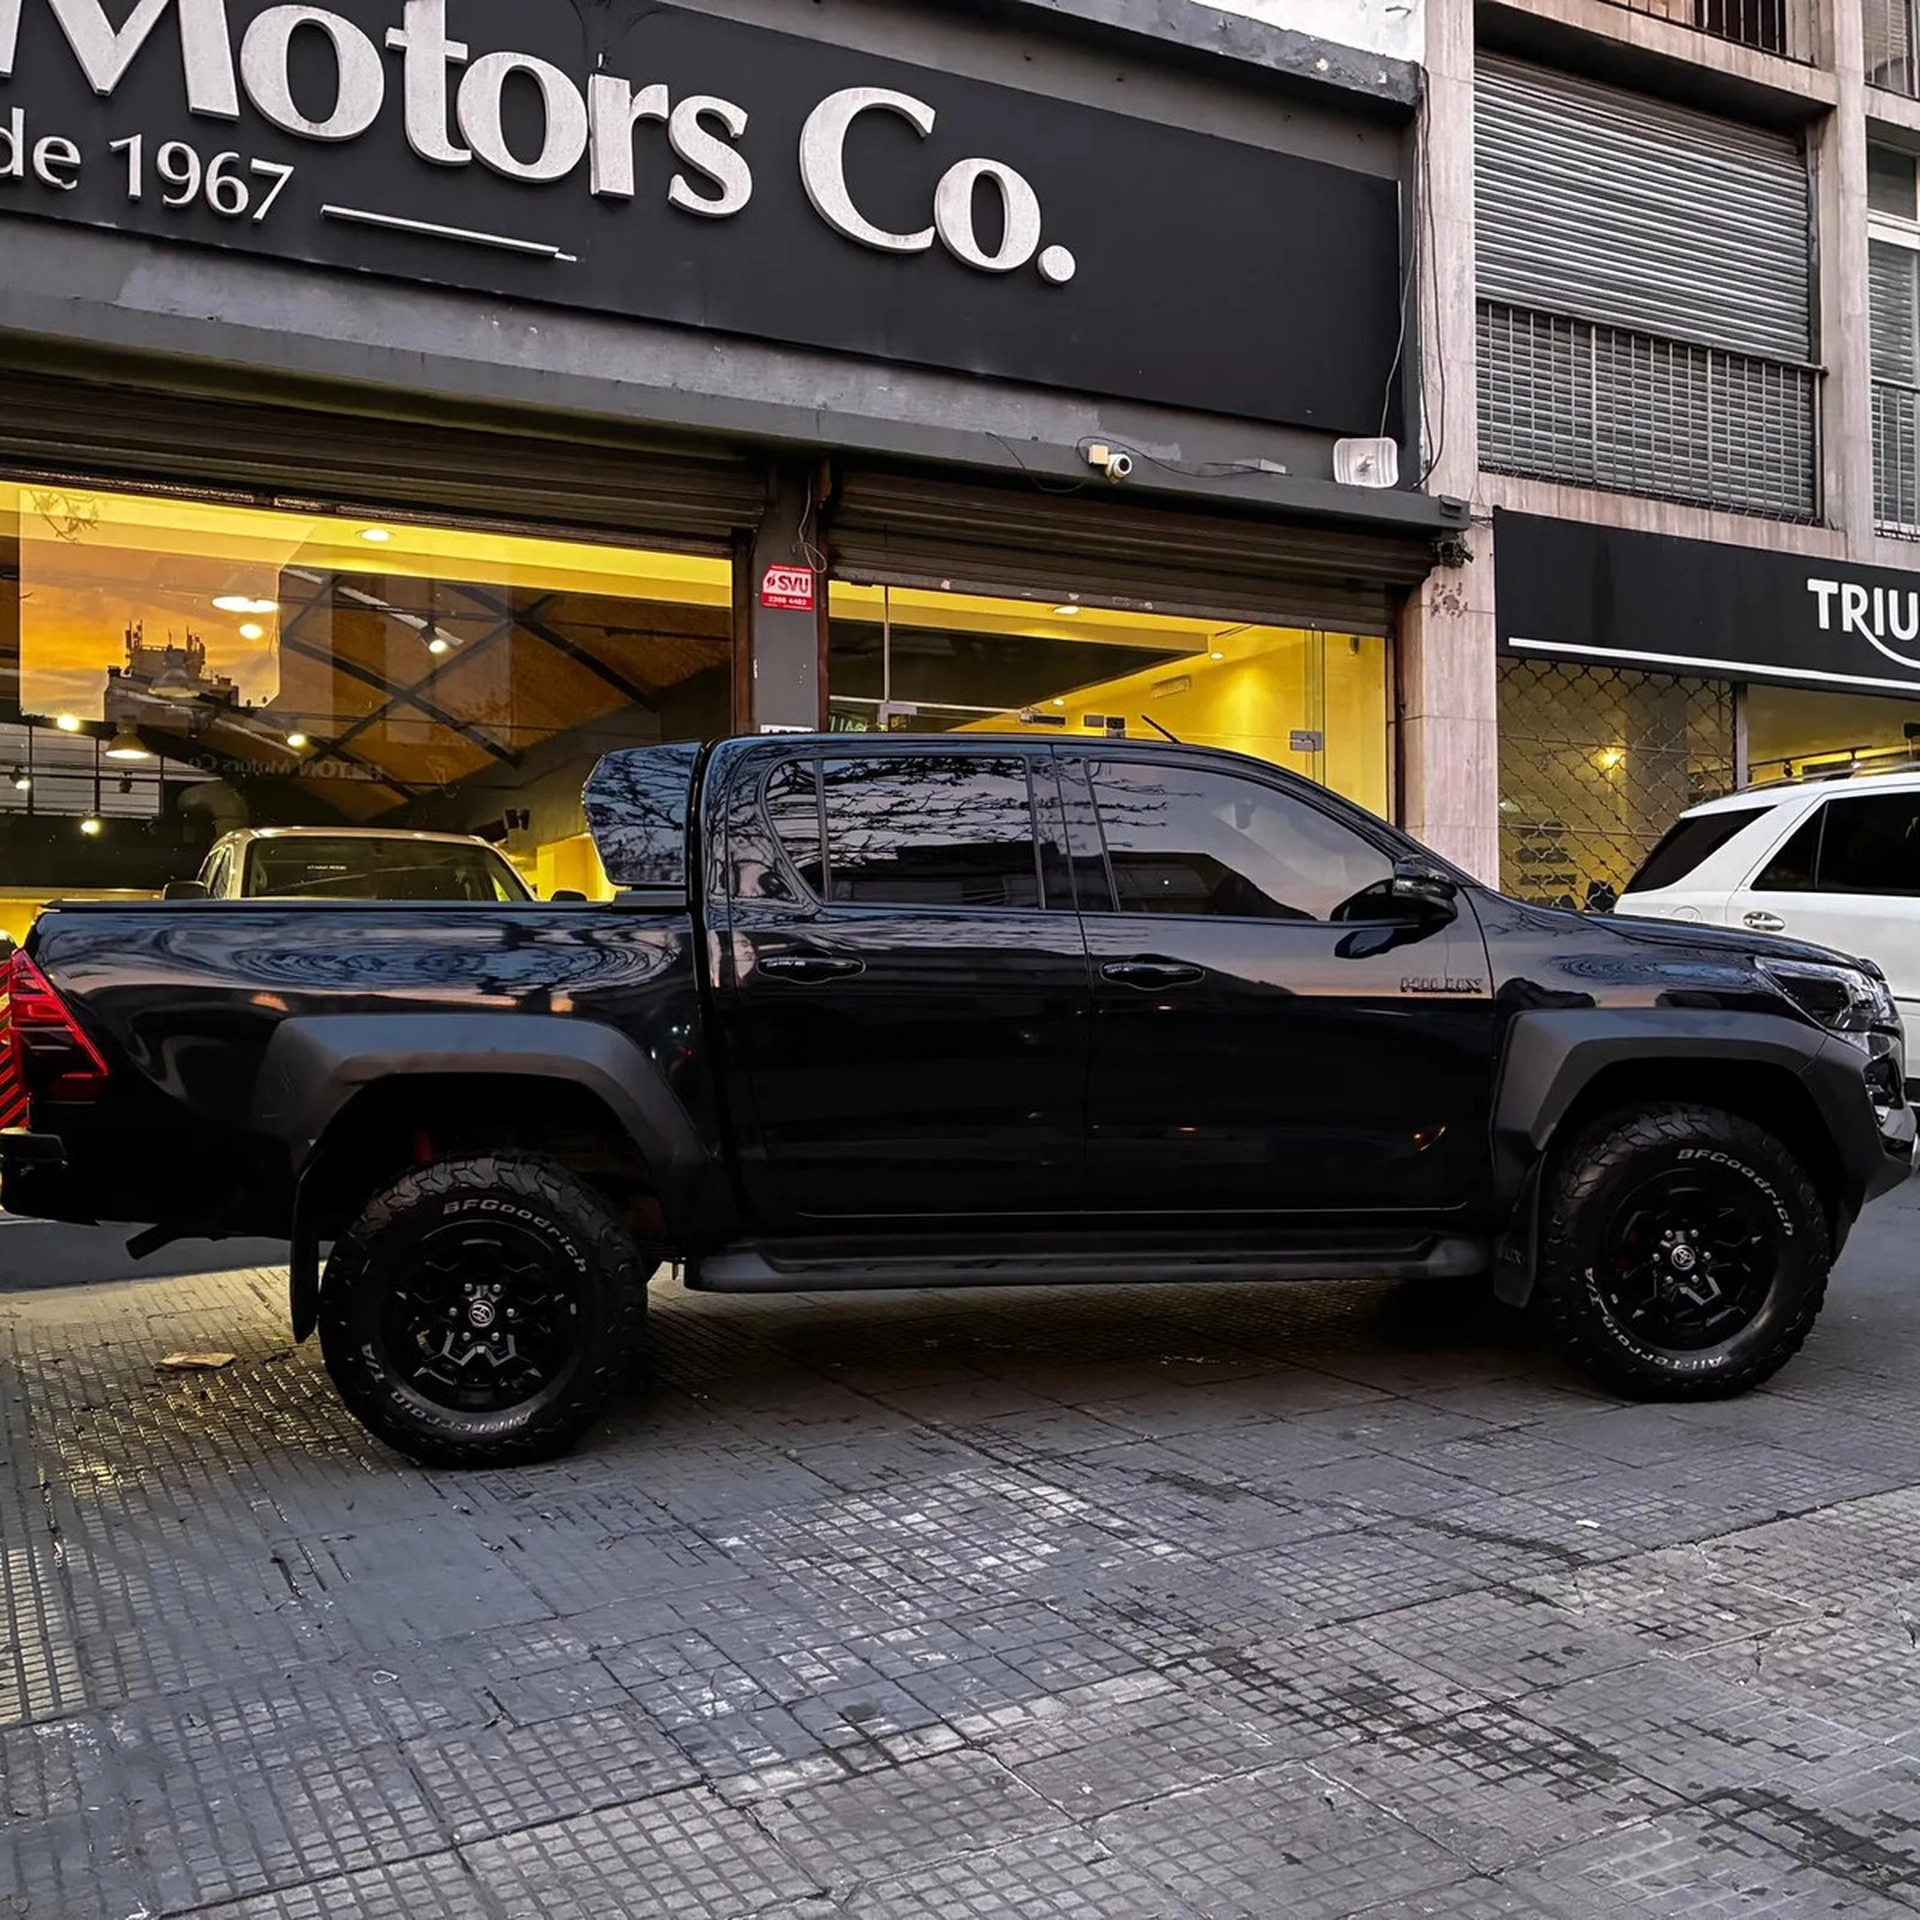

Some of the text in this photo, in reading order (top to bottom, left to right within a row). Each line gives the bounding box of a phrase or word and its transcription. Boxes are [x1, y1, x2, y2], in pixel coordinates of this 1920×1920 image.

[0, 0, 1076, 285] Motors Co.
[109, 132, 294, 222] 1967
[777, 575, 809, 594] SVU
[1807, 578, 1920, 669] TRIU
[443, 1199, 588, 1273] BFGoodrich
[1676, 1148, 1795, 1237] BFGoodrich
